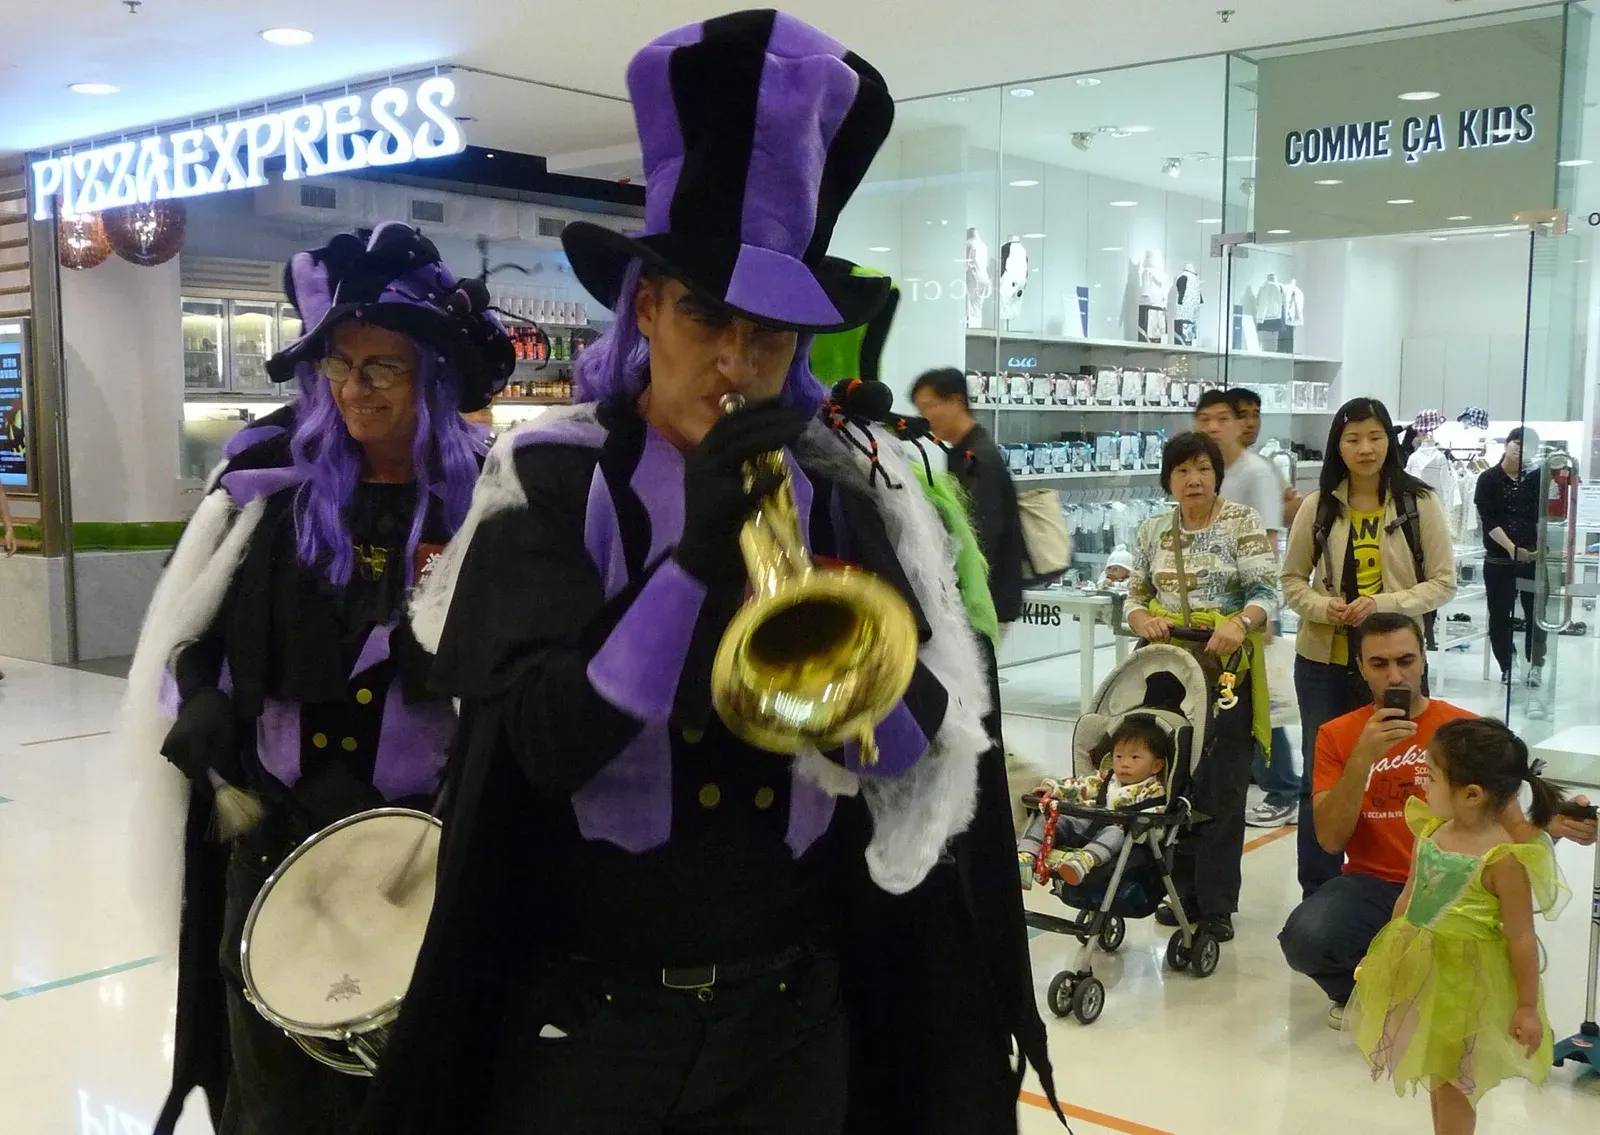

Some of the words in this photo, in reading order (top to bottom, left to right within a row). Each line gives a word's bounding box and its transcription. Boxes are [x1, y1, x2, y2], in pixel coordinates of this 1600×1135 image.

[32, 77, 464, 221] PIZZAEXPRESS
[1285, 120, 1391, 166] COMME
[1402, 114, 1445, 162] ÇA
[1458, 103, 1534, 149] KIDS
[1022, 602, 1061, 626] KIDS
